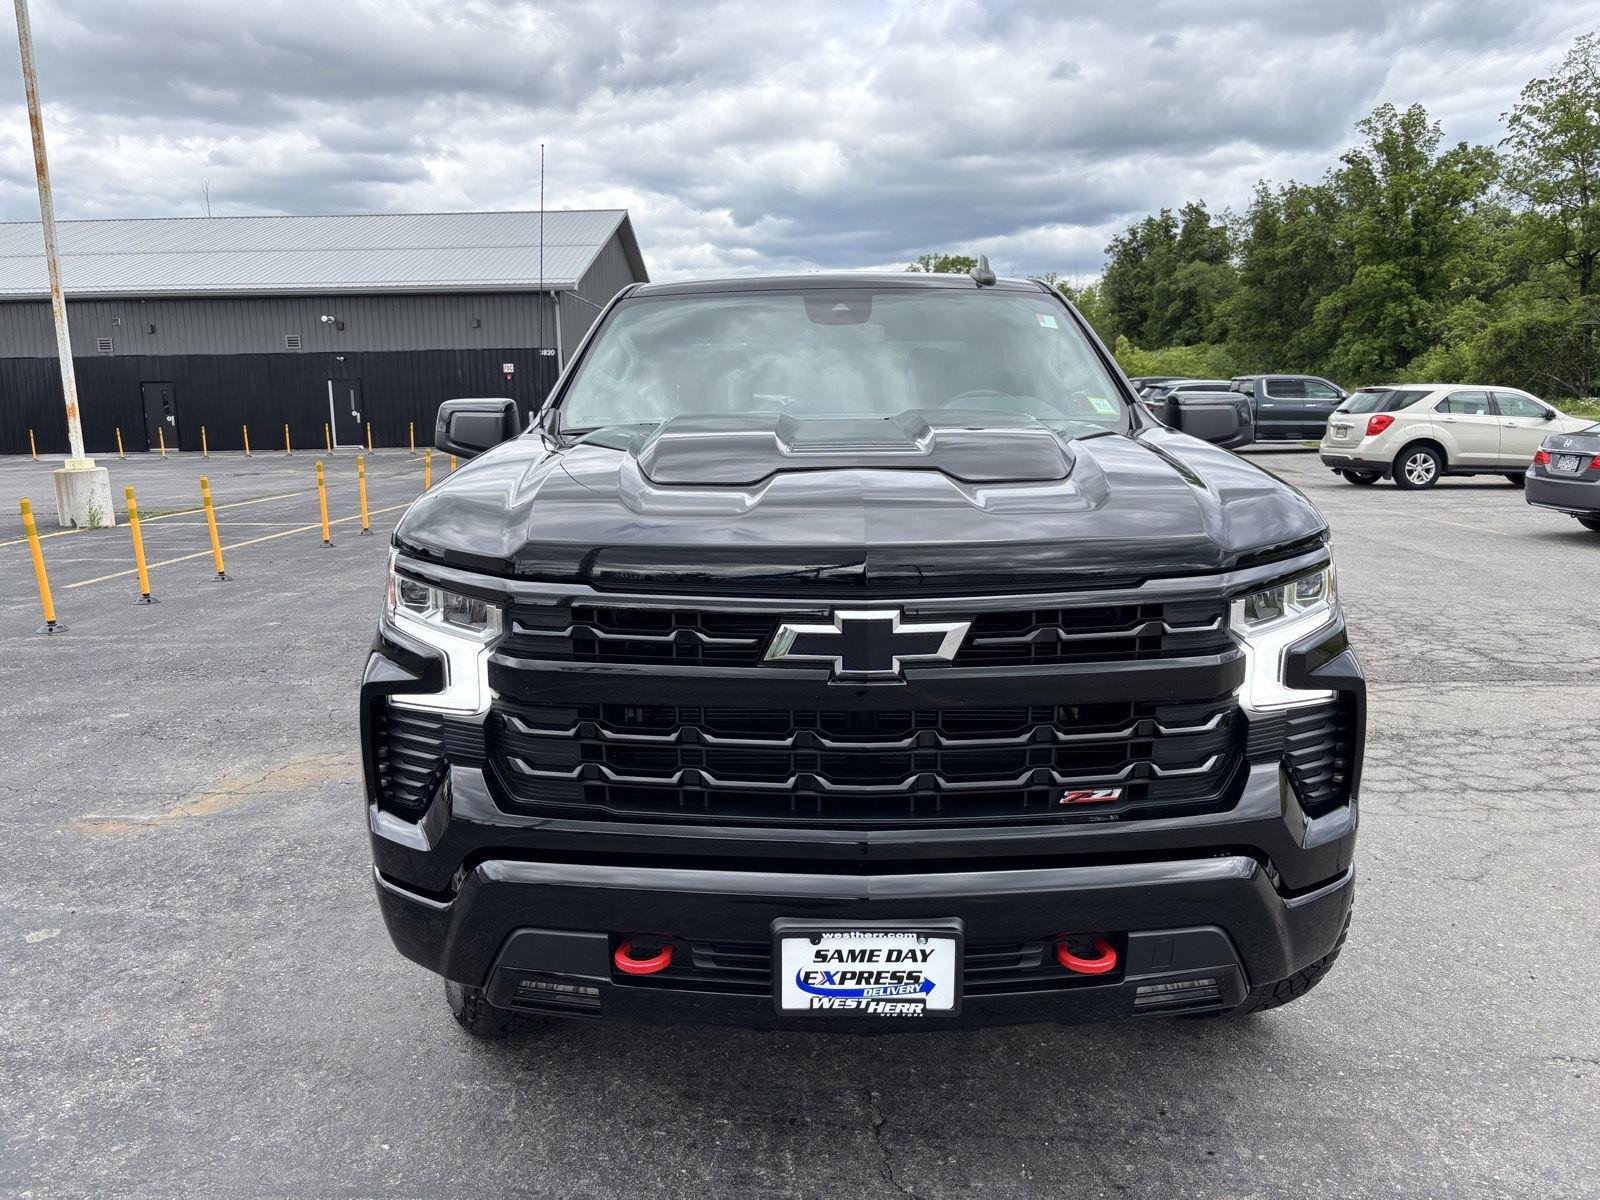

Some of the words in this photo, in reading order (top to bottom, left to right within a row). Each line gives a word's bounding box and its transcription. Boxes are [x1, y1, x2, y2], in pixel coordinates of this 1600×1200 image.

[822, 931, 917, 939] westherr.com
[813, 949, 882, 963] SAME
[885, 949, 935, 963] DAY
[803, 970, 923, 986] EXPRESS
[863, 984, 923, 997] DELIVERY
